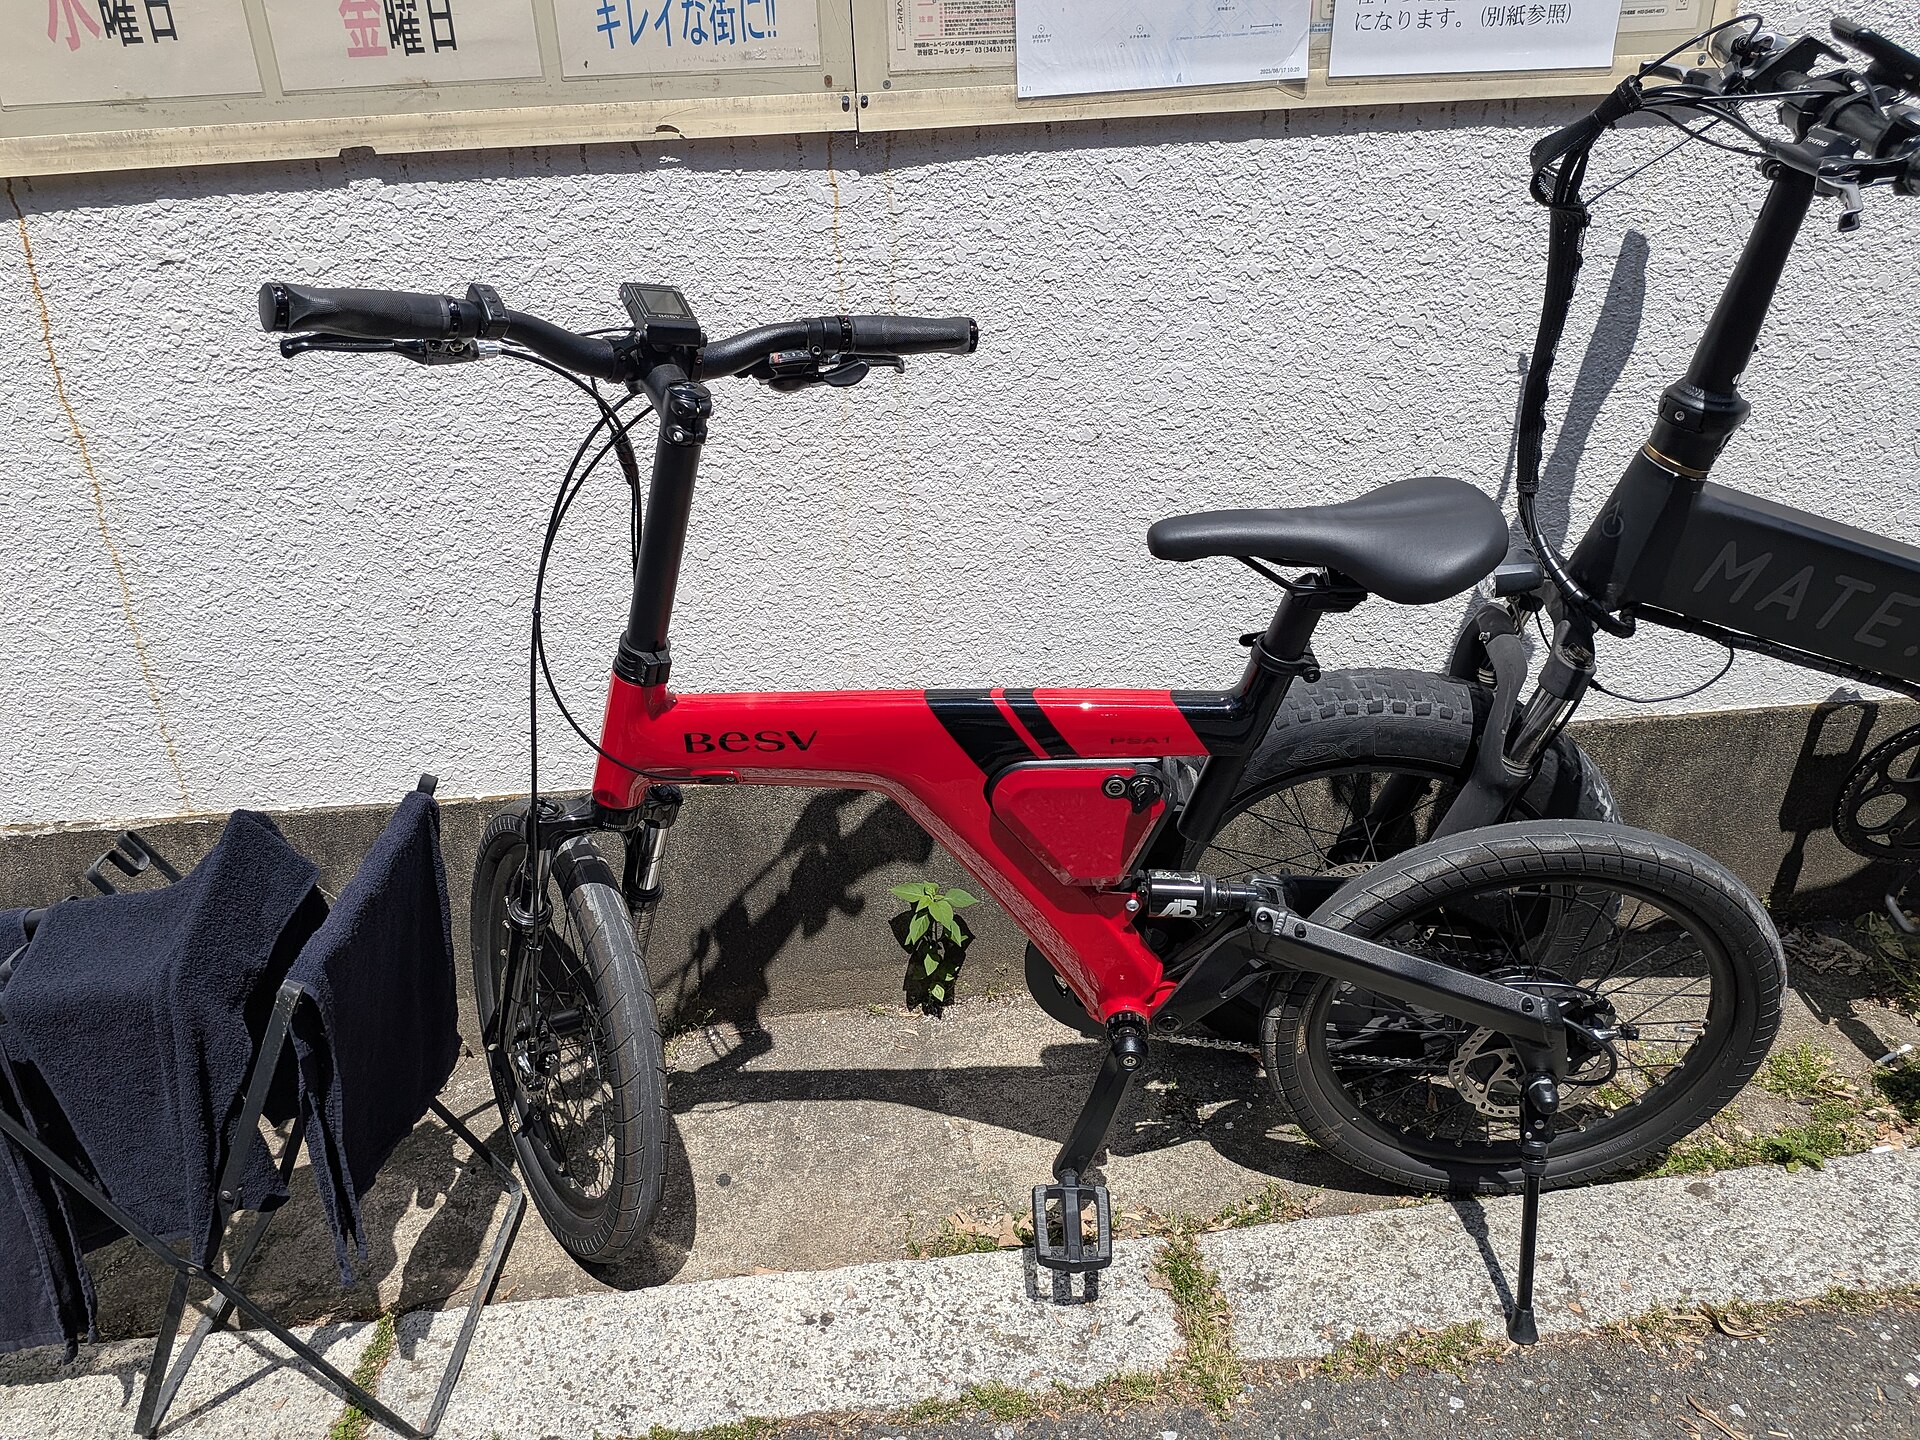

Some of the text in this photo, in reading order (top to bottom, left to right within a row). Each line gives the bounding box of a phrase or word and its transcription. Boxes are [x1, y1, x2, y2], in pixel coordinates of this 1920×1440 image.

[47, 0, 178, 52] 水曜日
[338, 0, 457, 57] 金曜日
